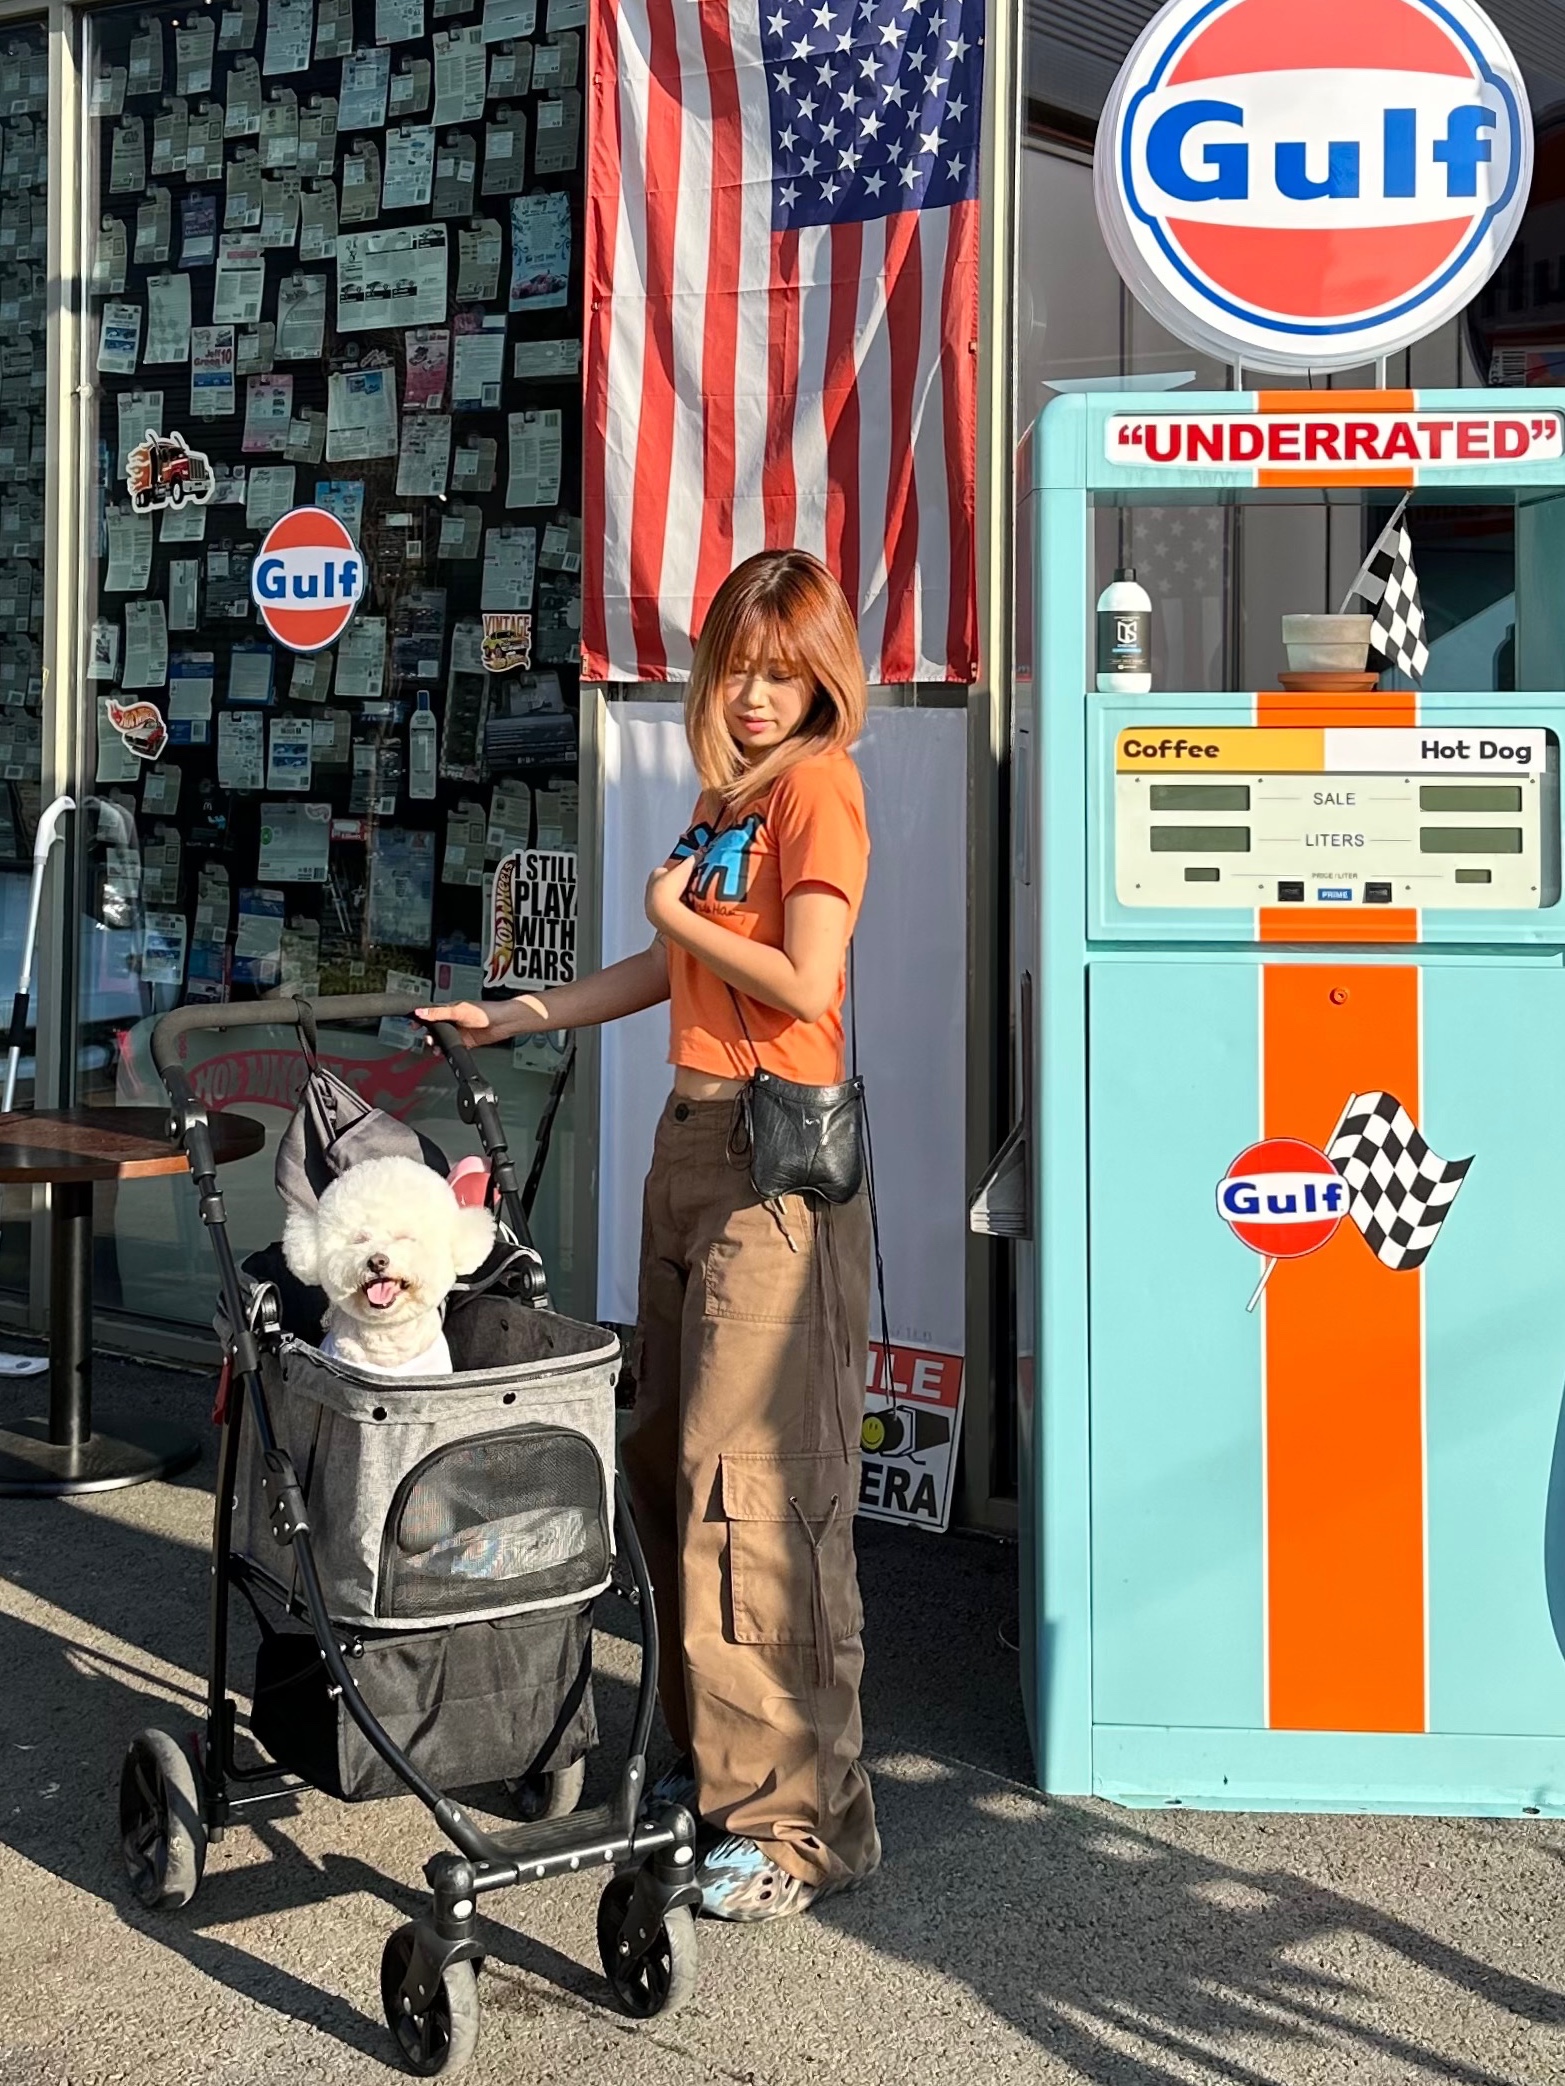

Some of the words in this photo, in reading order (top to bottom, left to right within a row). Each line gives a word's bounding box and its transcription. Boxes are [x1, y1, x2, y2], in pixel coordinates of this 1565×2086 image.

[1145, 99, 1498, 203] Gulf
[255, 557, 360, 599] Gulf
[483, 615, 530, 638] VINTAGE
[1122, 738, 1220, 760] Coffee
[1420, 739, 1471, 761] Hot
[1479, 739, 1532, 765] Dog
[1312, 791, 1357, 807] SALE
[1305, 832, 1365, 848] LITERS
[515, 853, 521, 879] I
[526, 854, 577, 883] STILL
[514, 880, 576, 919] PLAY
[1321, 890, 1349, 899] PRIME
[514, 916, 576, 951] WITH
[512, 947, 575, 983] CARS
[1222, 1181, 1344, 1215] Gulf
